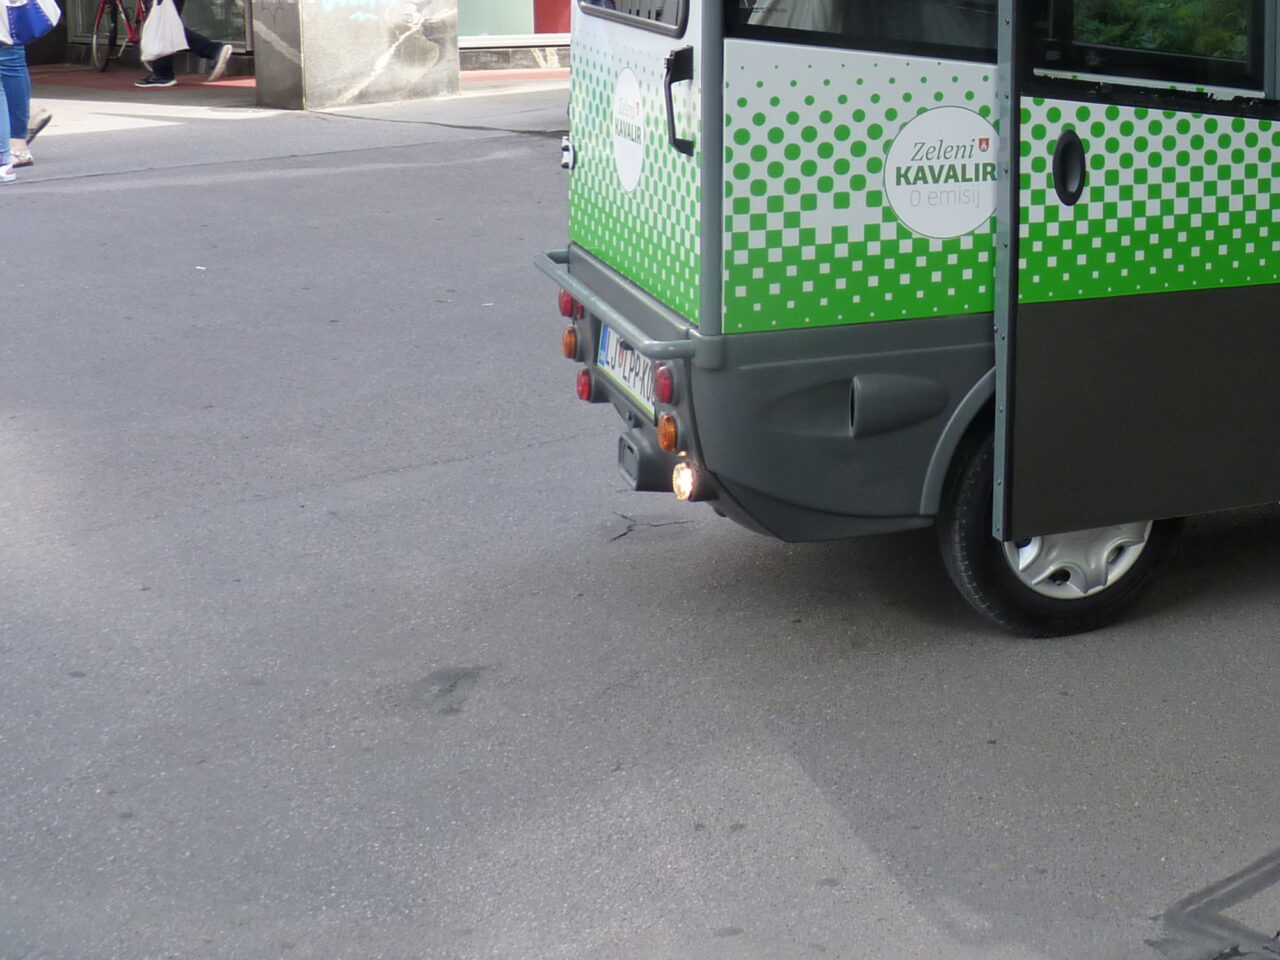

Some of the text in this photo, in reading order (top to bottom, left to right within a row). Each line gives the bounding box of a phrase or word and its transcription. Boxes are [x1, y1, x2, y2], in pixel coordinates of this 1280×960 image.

[615, 117, 641, 145] KAVALIR
[910, 138, 976, 162] Zeleni
[895, 162, 998, 186] KAVALIR
[927, 184, 980, 209] emisij
